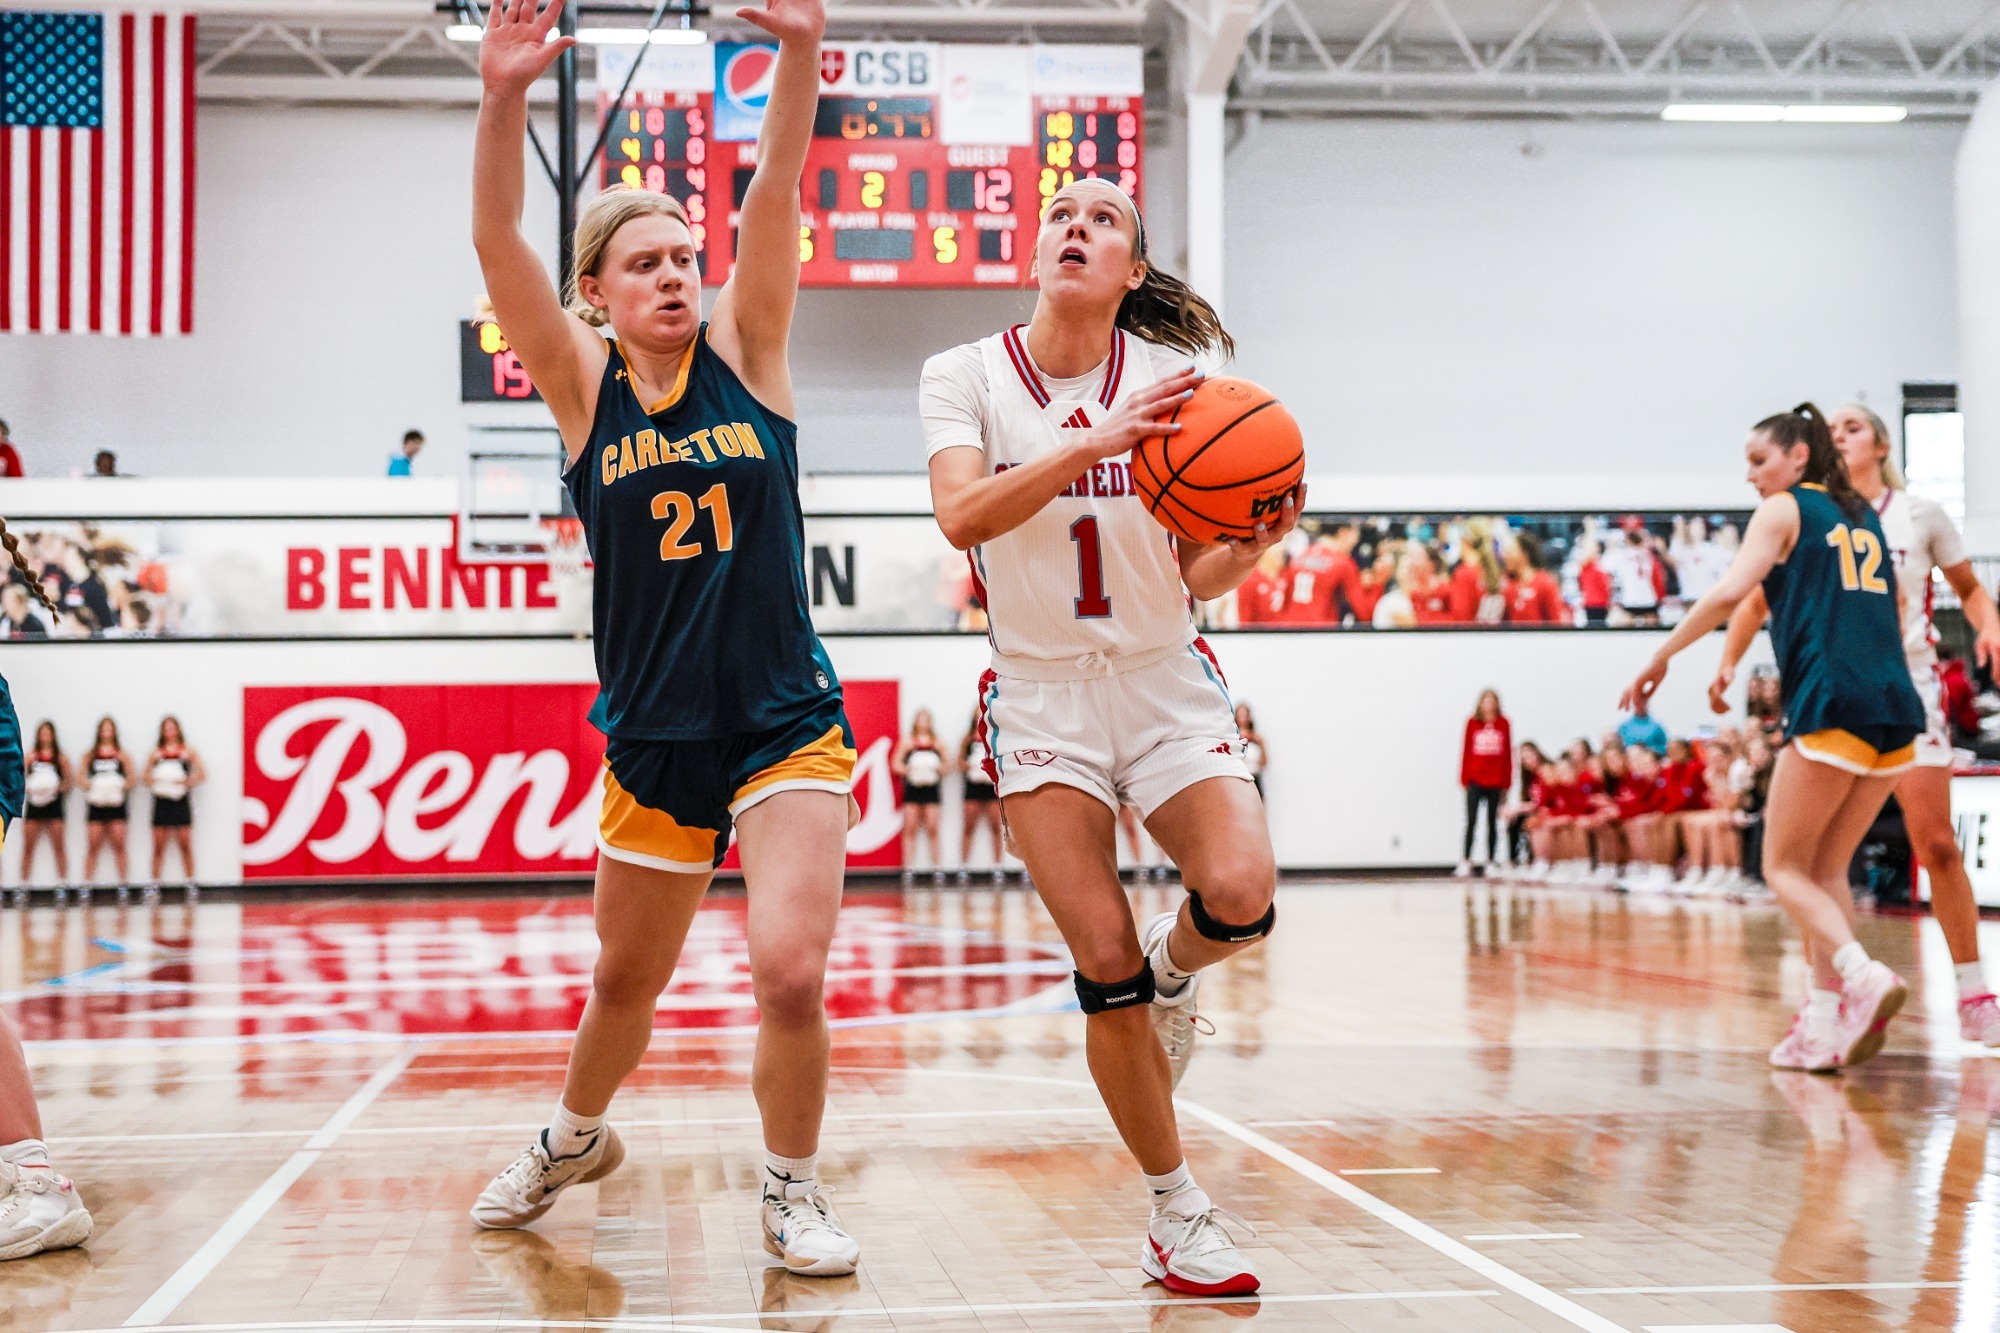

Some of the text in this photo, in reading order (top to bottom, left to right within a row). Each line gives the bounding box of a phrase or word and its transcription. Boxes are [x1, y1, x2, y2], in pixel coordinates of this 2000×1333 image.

[855, 51, 927, 85] CSB
[948, 146, 1008, 167] GUEST
[861, 171, 885, 208] 2
[974, 169, 1012, 213] 12
[933, 226, 958, 264] 5
[1000, 229, 1013, 261] 1
[493, 350, 533, 398] 15
[601, 422, 765, 486] CARLETON
[651, 483, 733, 562] 21
[1069, 514, 1113, 619] 1
[1825, 523, 1888, 594] 12
